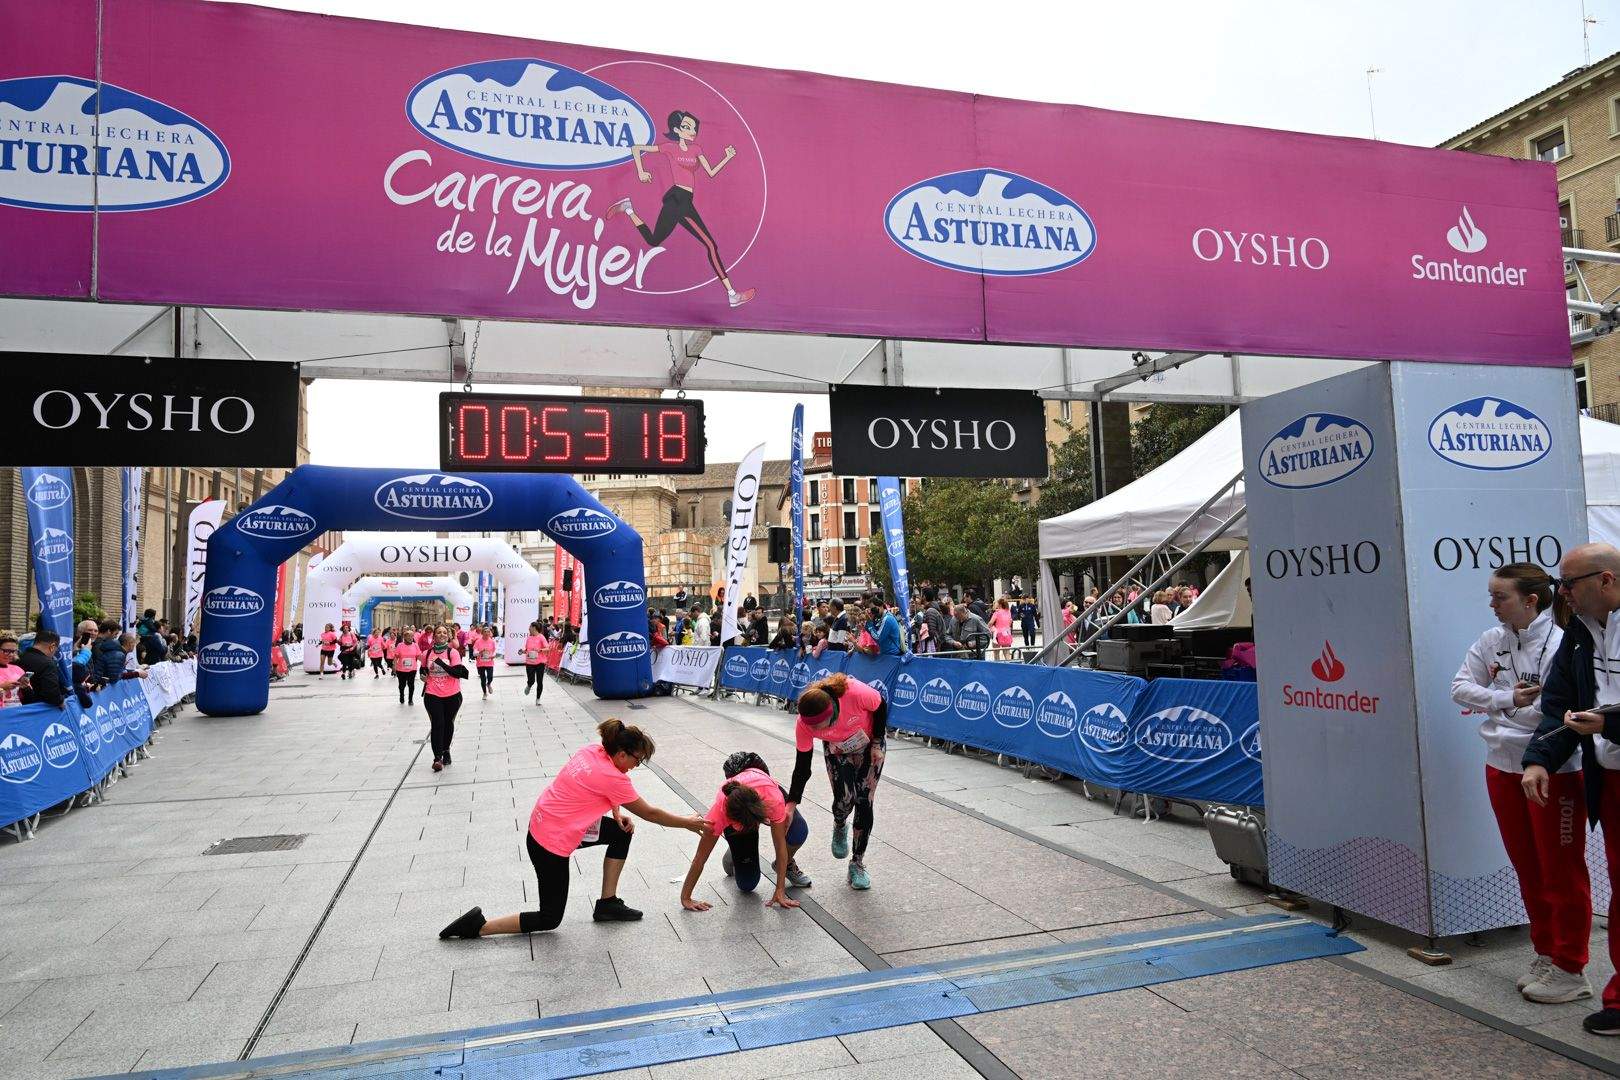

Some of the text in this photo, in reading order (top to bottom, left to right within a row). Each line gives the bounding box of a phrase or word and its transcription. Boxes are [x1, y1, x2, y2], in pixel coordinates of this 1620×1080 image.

[467, 89, 629, 117] CENTRAL LECHERA
[426, 89, 636, 148] ASTURIANA
[0, 119, 194, 145] NTRAL LECHERA
[383, 149, 593, 221] Carrera
[935, 201, 1074, 221] CENTRAL LECHERA
[902, 201, 1082, 252] ASTURIANA
[436, 213, 667, 310] de la Mujer
[1191, 227, 1330, 271] OYSHO
[1411, 254, 1527, 287] Santander
[32, 389, 256, 434] OYSHO
[642, 411, 687, 463] 18
[867, 416, 1017, 451] OYSHO
[1438, 423, 1545, 452] ASTURIANA
[1456, 421, 1538, 431] CENTRAL LECHERA
[1281, 428, 1360, 453] CENTRAL LECHERA
[1266, 440, 1366, 478] ASTURIANA
[384, 487, 484, 509] ASTURIANA
[241, 517, 310, 531] ASTURIANA
[553, 520, 613, 532] ASTURIANA
[380, 544, 472, 563] OYSHO
[1266, 540, 1381, 579] OYSHO
[1433, 535, 1562, 571] OYSHO
[322, 565, 353, 573] OYSHO
[496, 562, 523, 570] OYSHO
[204, 599, 260, 611] ASTURIANA
[510, 597, 536, 605] OYSHO
[597, 592, 643, 604] ASTURIANA
[201, 652, 254, 665] ASTURIANA
[600, 642, 646, 655] ASTURIANA
[671, 649, 709, 669] OYSHO
[921, 689, 951, 706] ASTURIANA
[956, 693, 988, 713] ASTURIANA
[994, 698, 1031, 720] ASTURIANA
[1282, 683, 1380, 715] Santander
[1140, 724, 1223, 751] ASTURIANA
